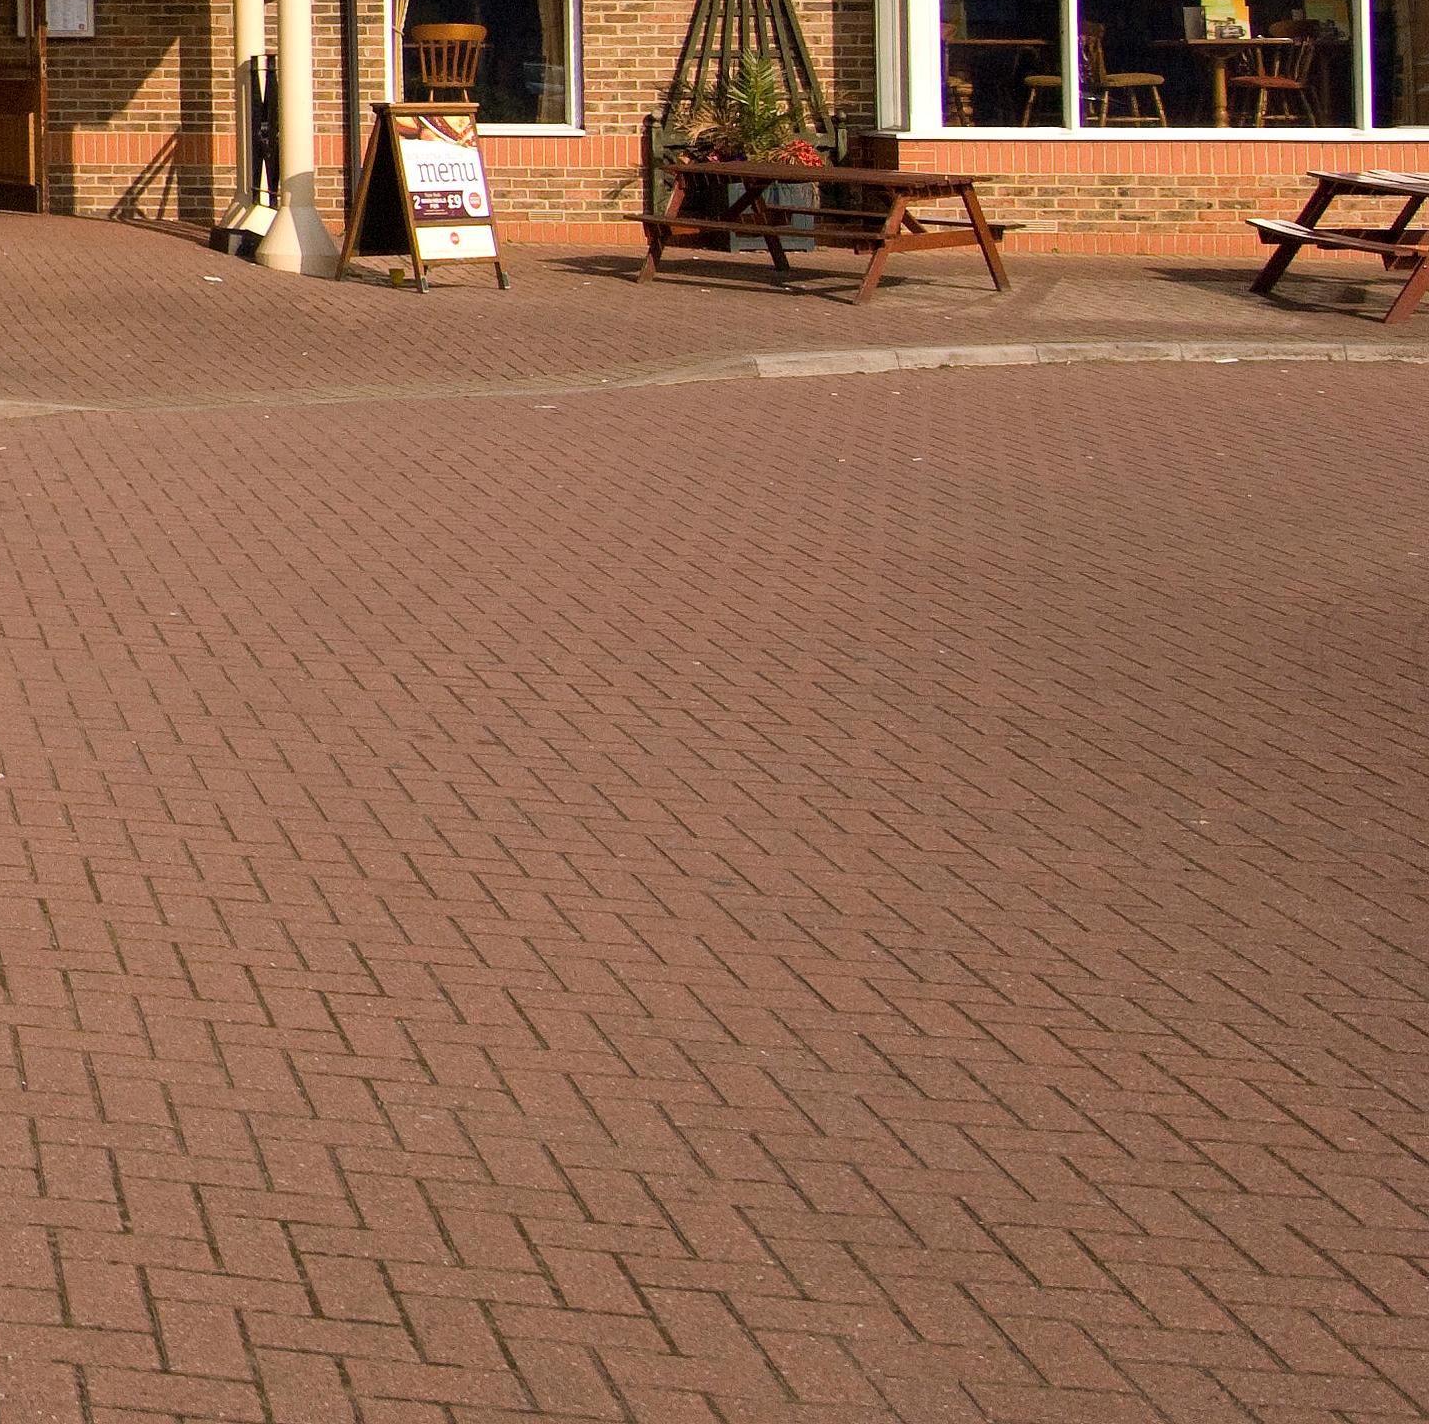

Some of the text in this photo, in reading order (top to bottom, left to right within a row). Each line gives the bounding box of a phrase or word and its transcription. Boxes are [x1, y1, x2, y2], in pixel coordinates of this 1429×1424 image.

[417, 161, 478, 183] menu
[412, 195, 422, 210] 2
[447, 194, 462, 209] £9
